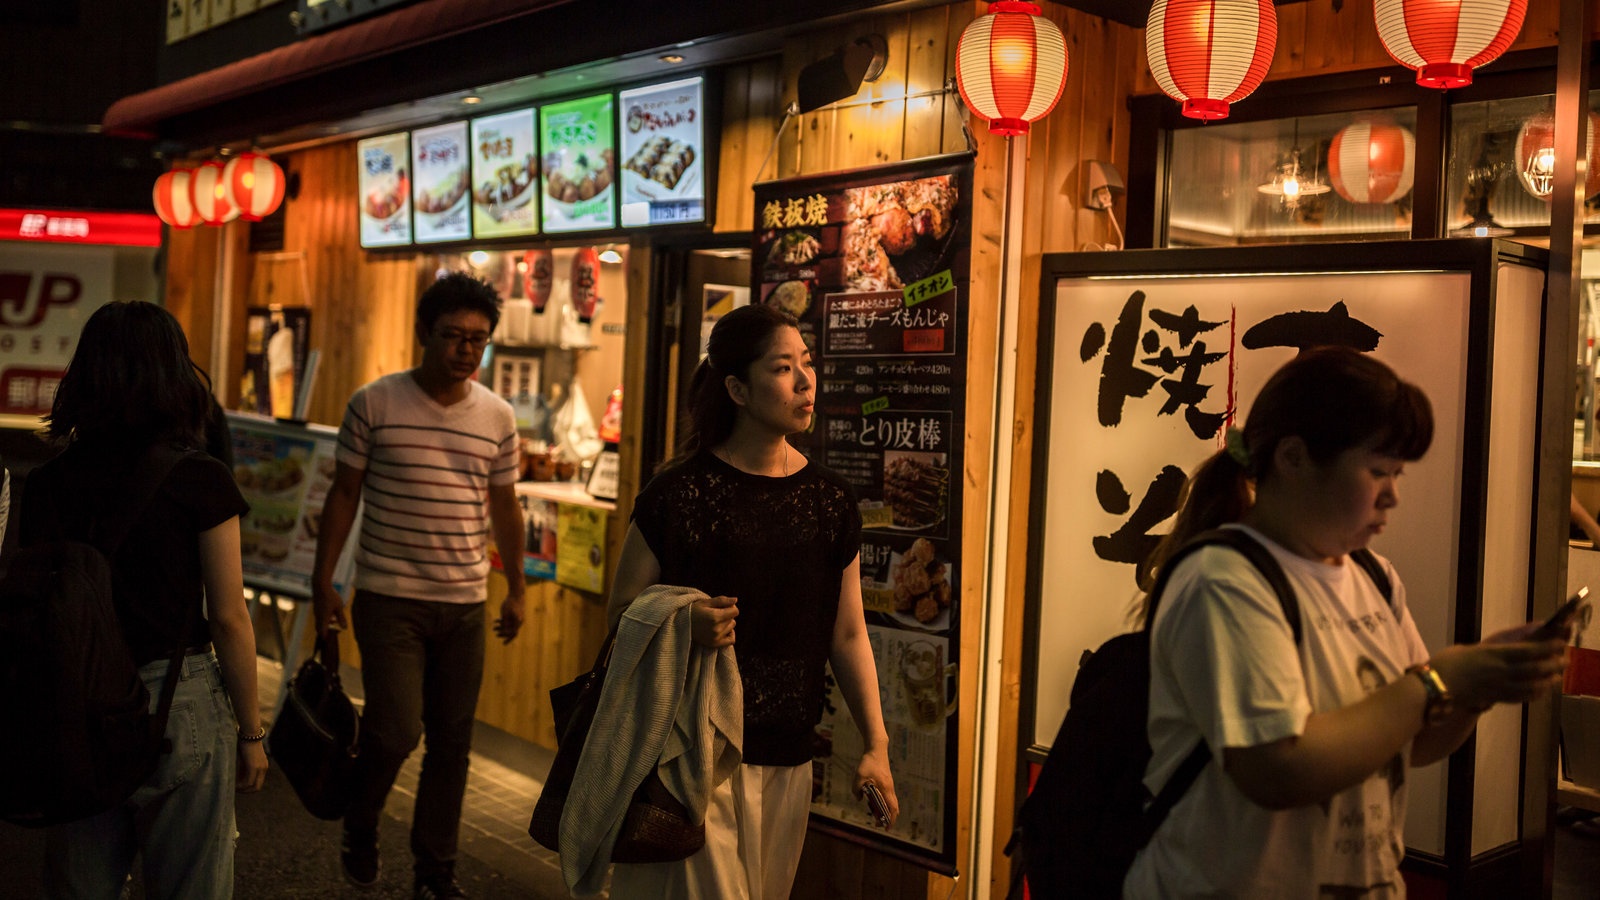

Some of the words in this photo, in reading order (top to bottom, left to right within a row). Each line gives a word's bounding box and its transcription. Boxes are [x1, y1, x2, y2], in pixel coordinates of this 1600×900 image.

[762, 193, 829, 229] 鉄板焼
[0, 271, 82, 329] JP
[907, 277, 949, 301] イチオシ
[828, 308, 949, 329] 銀だこ流チーズもんじゃ
[859, 418, 942, 450] とり皮棒
